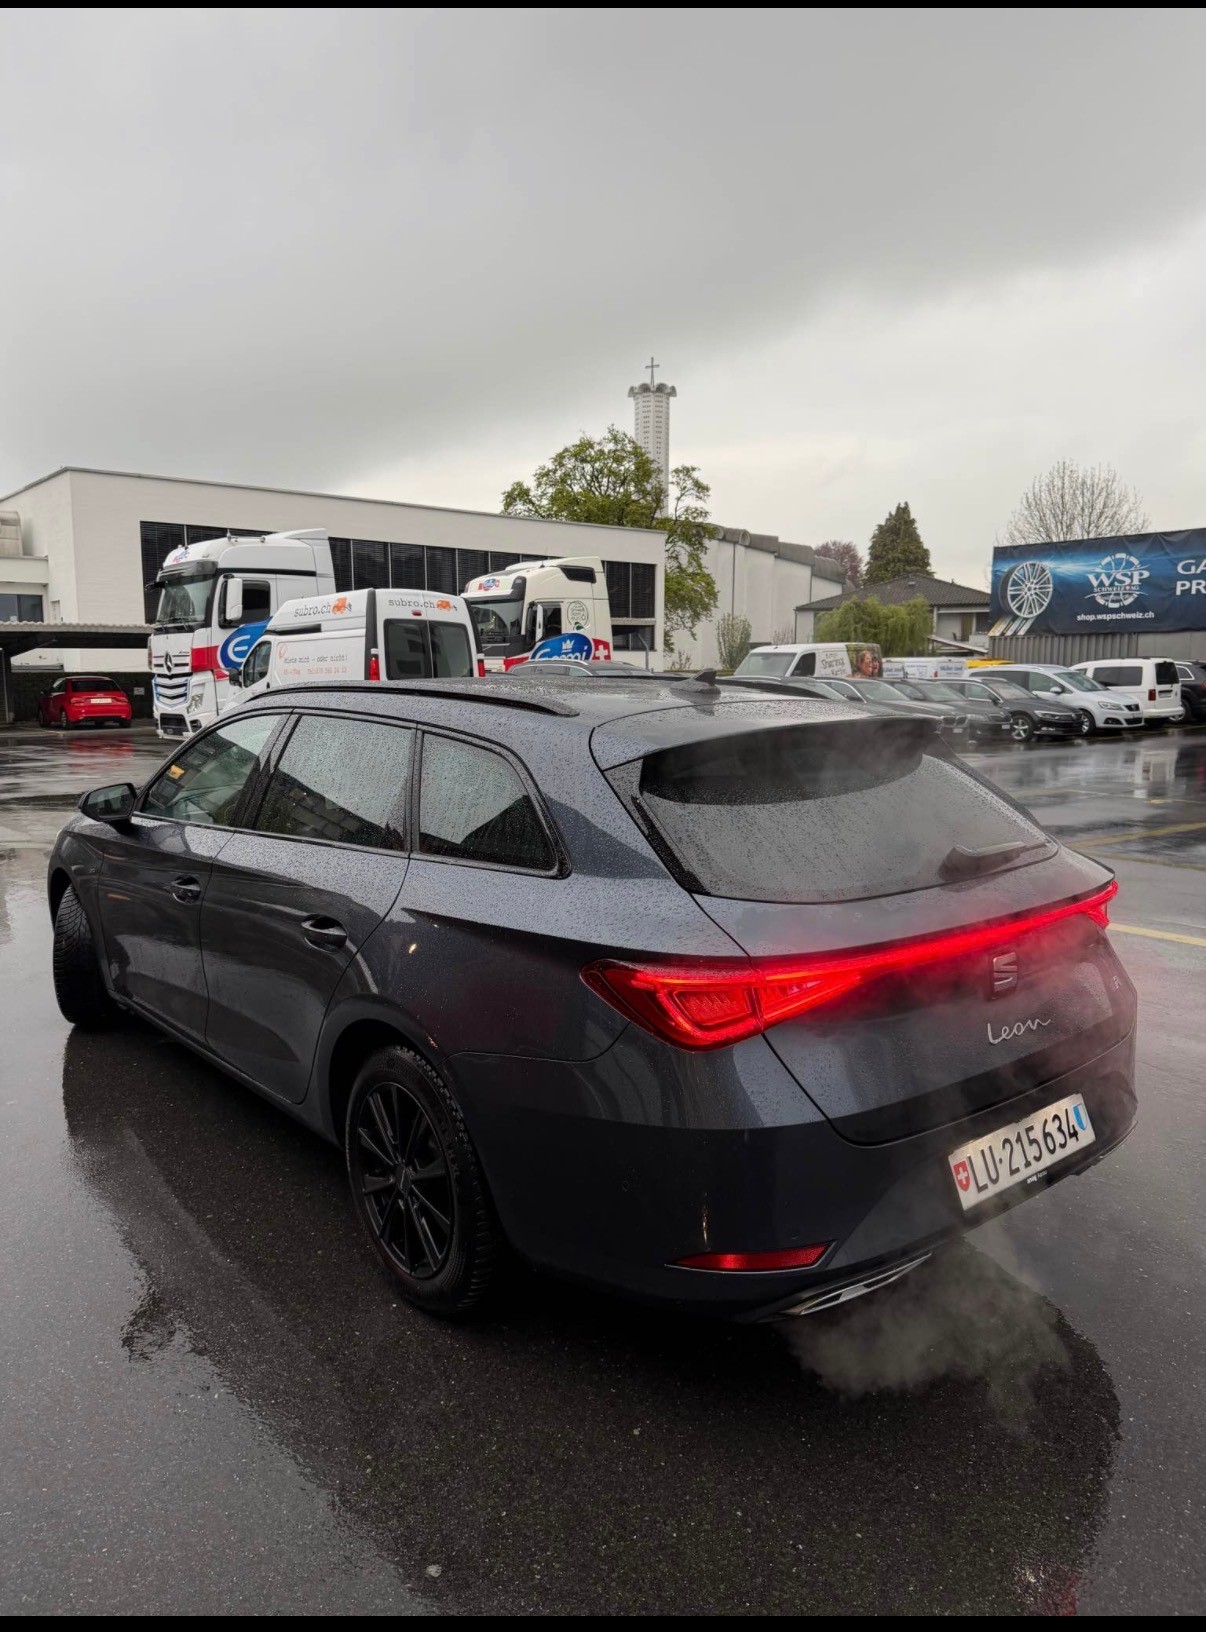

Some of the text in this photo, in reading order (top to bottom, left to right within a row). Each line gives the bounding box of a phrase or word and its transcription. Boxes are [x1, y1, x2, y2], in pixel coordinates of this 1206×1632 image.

[1087, 570, 1150, 587] WSP
[1175, 579, 1206, 595] PR
[294, 602, 331, 617] subro.ch
[388, 598, 435, 609] subro.ch
[1076, 611, 1155, 622] shop.wspschweiz.ch
[987, 1016, 1051, 1045] Leon
